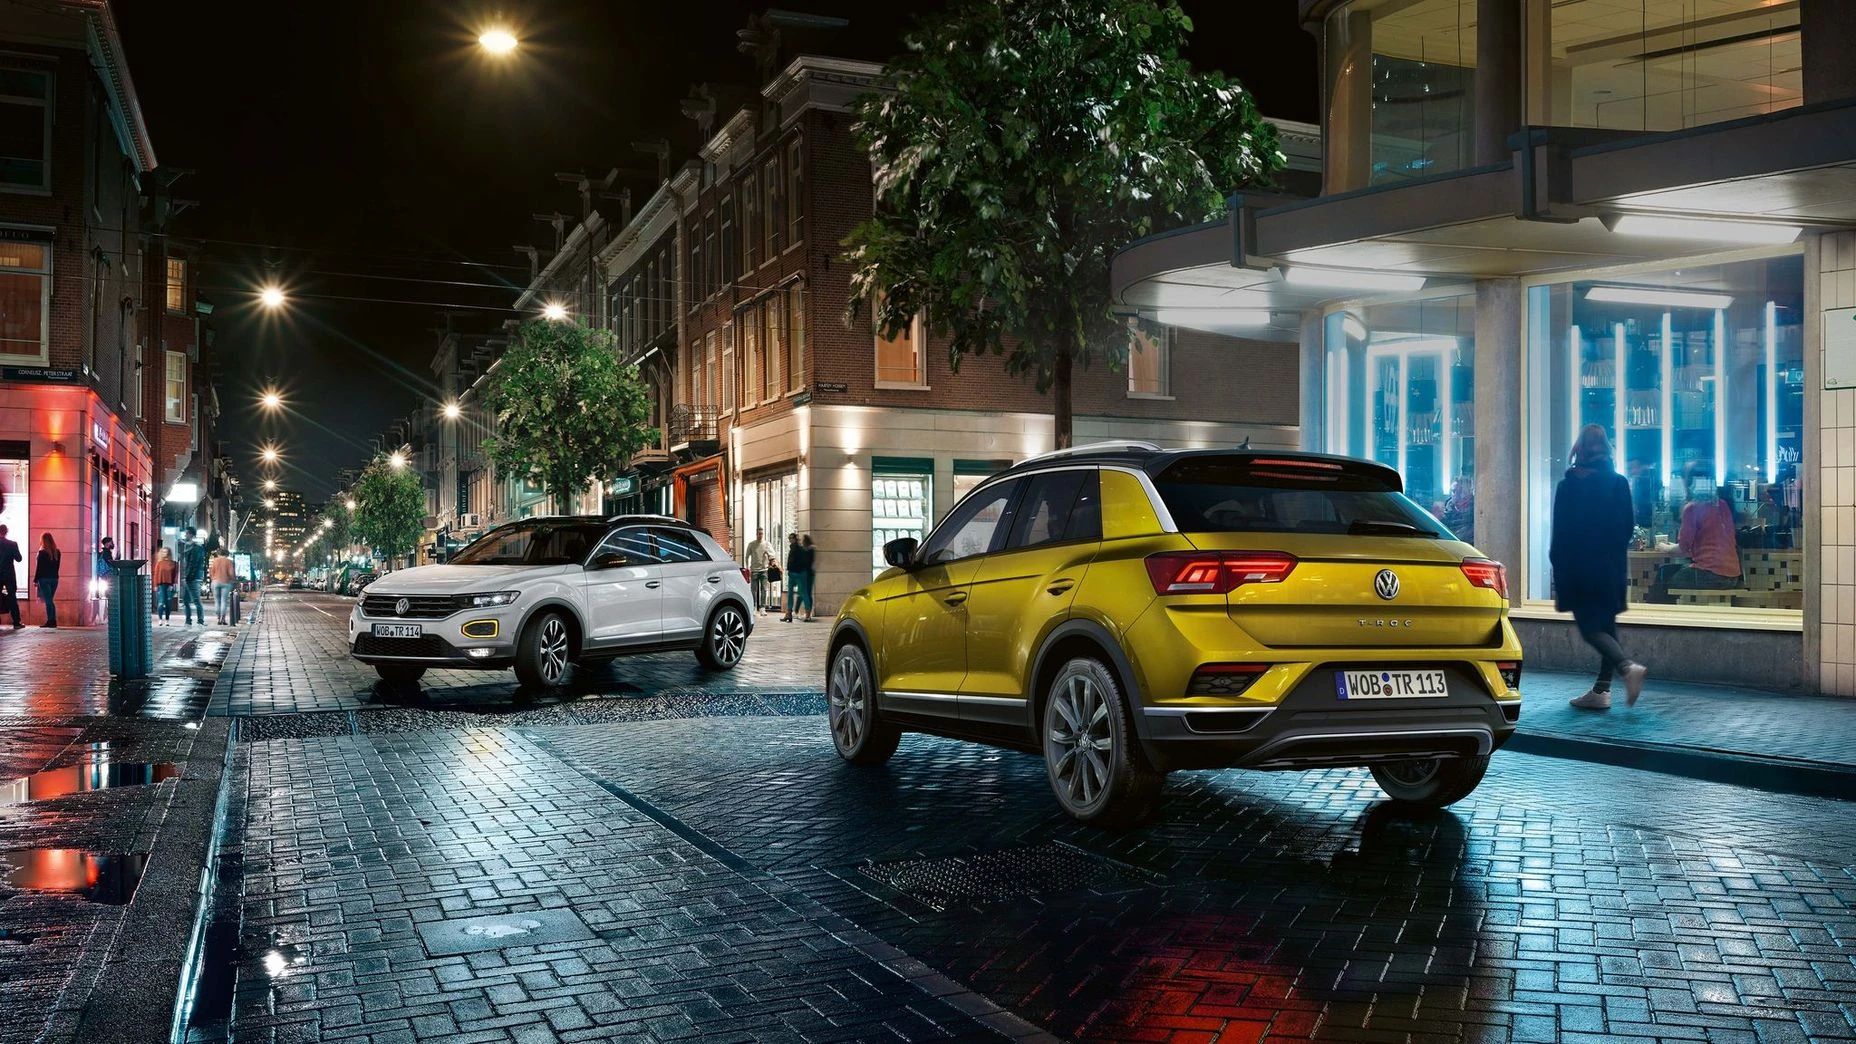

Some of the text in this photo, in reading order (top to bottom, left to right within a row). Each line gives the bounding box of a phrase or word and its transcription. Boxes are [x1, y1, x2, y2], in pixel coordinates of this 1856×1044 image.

[1358, 619, 1412, 627] T-ROC
[376, 625, 419, 637] WOB TR 114
[1347, 674, 1381, 695] WOB
[1392, 673, 1414, 695] TR
[1416, 673, 1446, 694] 113
